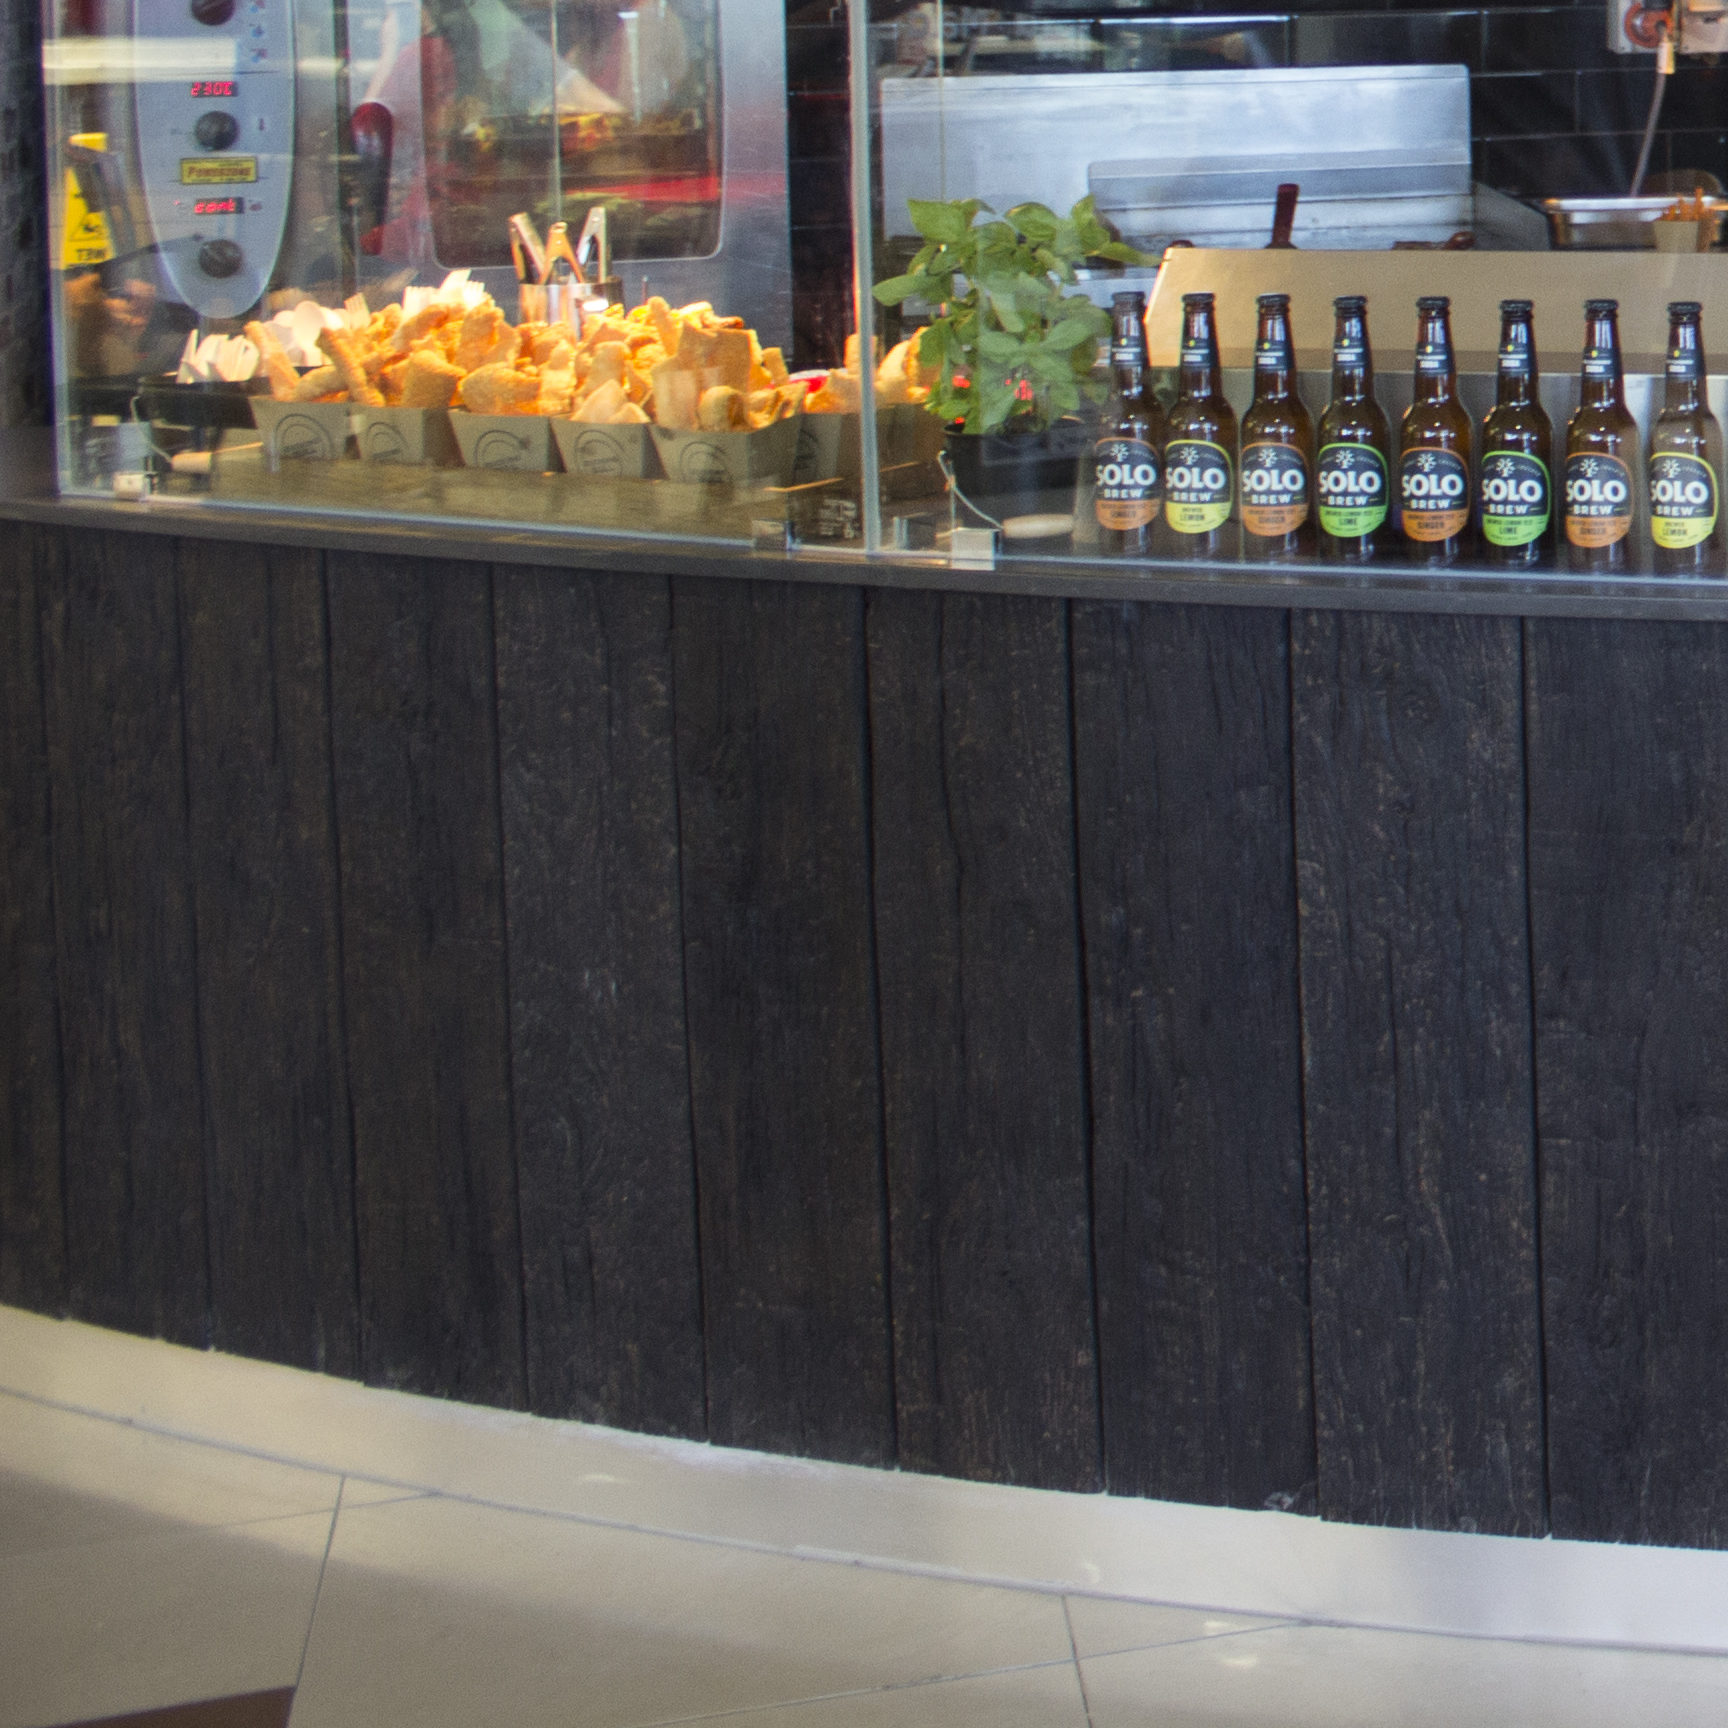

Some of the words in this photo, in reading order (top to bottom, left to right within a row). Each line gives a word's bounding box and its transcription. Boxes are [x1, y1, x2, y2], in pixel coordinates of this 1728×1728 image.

[1095, 464, 1156, 487] SOLO
[1166, 466, 1226, 490] SOLO
[1242, 468, 1305, 492] SOLO
[1319, 470, 1382, 493] SOLO
[1104, 488, 1143, 499] BREW
[1402, 473, 1464, 497] SOLO
[1482, 478, 1543, 503] SOLO
[1566, 478, 1627, 503] SOLO
[1651, 479, 1708, 504] SOLO
[1172, 492, 1212, 502] BREW
[1251, 494, 1292, 505] BREW
[1327, 495, 1367, 506] BREW
[1410, 499, 1451, 510] BREW
[1489, 504, 1528, 515] BREW
[1574, 504, 1613, 515] BREW
[1656, 505, 1694, 516] BREW
